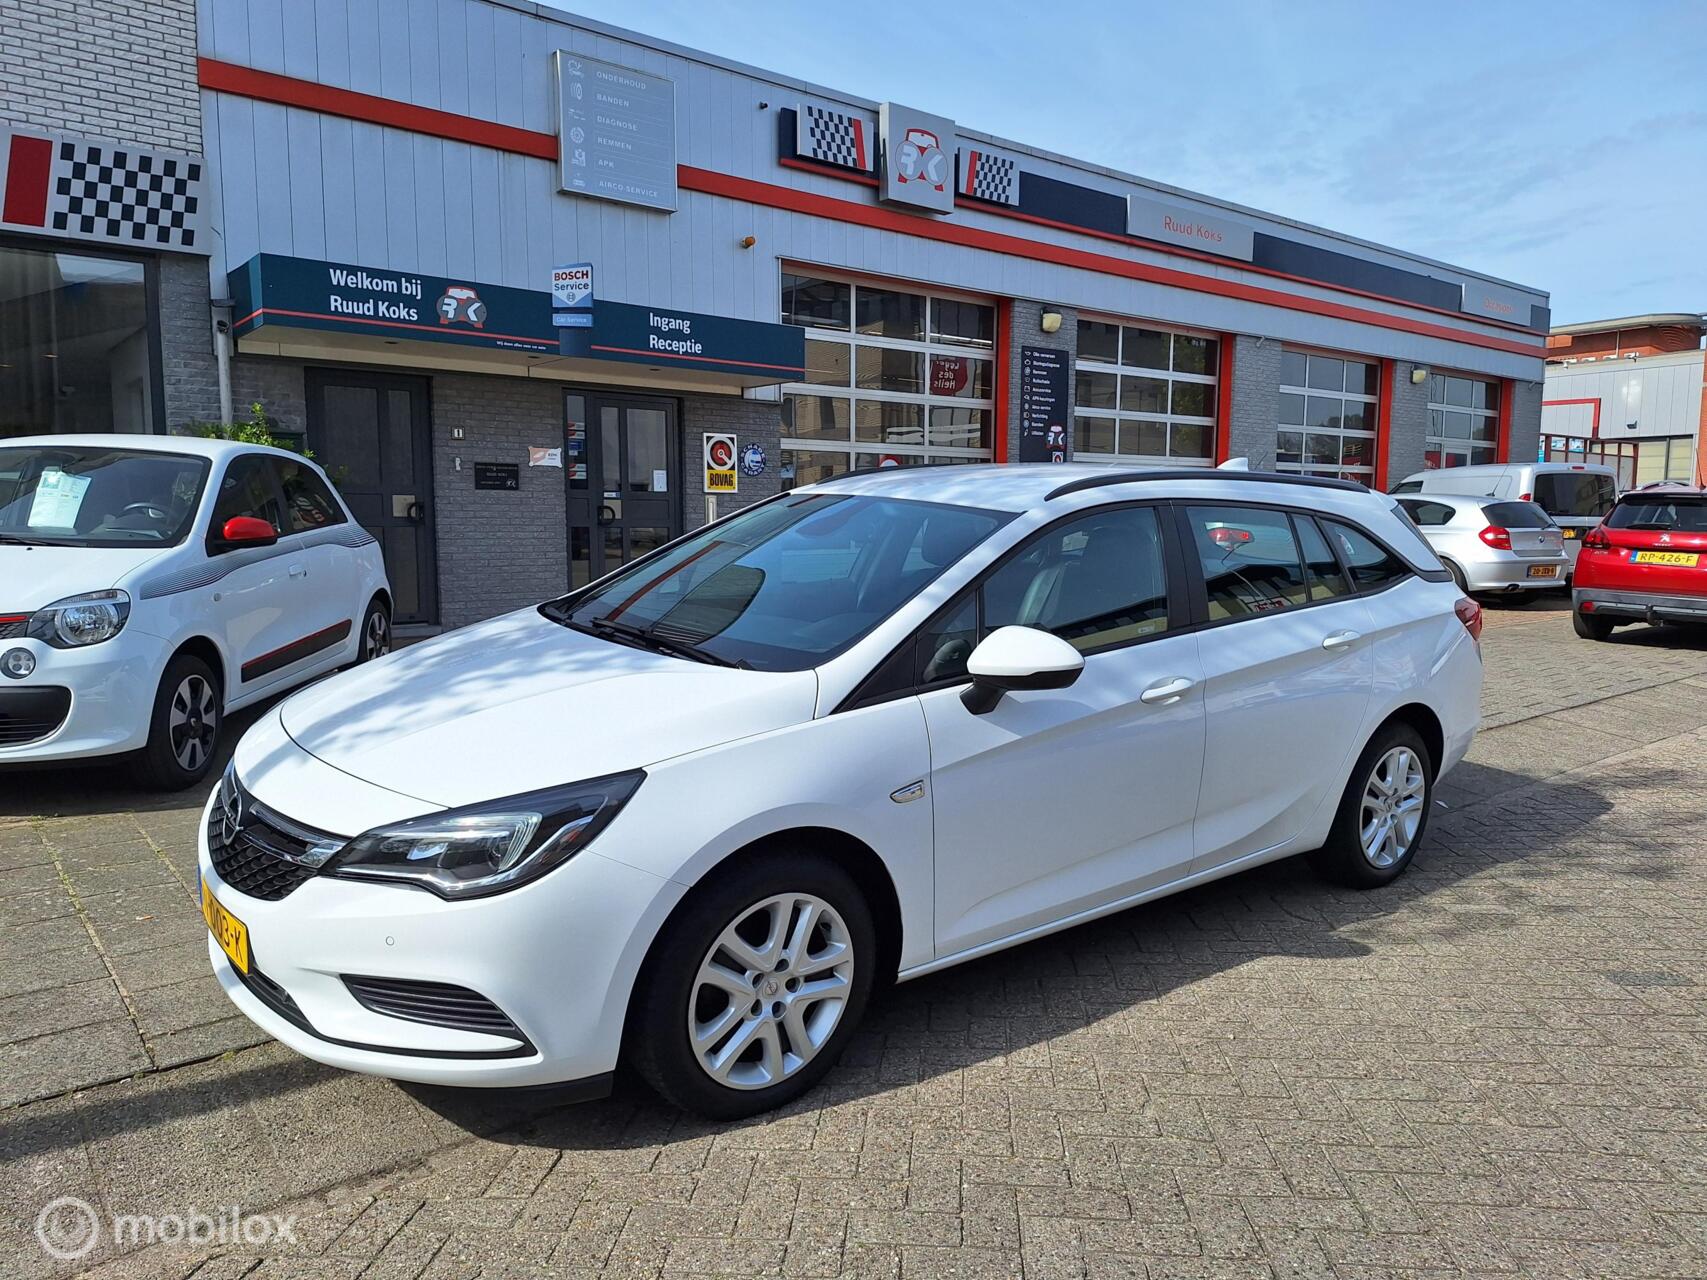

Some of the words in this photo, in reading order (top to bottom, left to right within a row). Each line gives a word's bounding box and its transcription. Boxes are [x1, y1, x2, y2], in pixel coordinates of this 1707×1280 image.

[596, 71, 646, 90] ONDERHOUD
[596, 93, 630, 107] BANDEN
[597, 115, 638, 131] DIAGNOSE
[598, 136, 632, 150] REMMEN
[598, 159, 615, 168] APK
[599, 181, 625, 191] AIRCO
[625, 185, 658, 198] SERVICE
[1164, 215, 1193, 236] Ruud
[1196, 224, 1222, 242] Koks
[329, 268, 398, 293] Welkom
[401, 278, 422, 299] bij
[554, 270, 589, 281] BOSCH
[554, 281, 590, 291] Service
[330, 295, 374, 317] Ruud
[378, 299, 418, 321] Koks
[649, 312, 691, 334] Ingang
[649, 334, 702, 354] Receptie
[709, 473, 734, 486] BOVAG
[1639, 552, 1694, 564] RP-426-F
